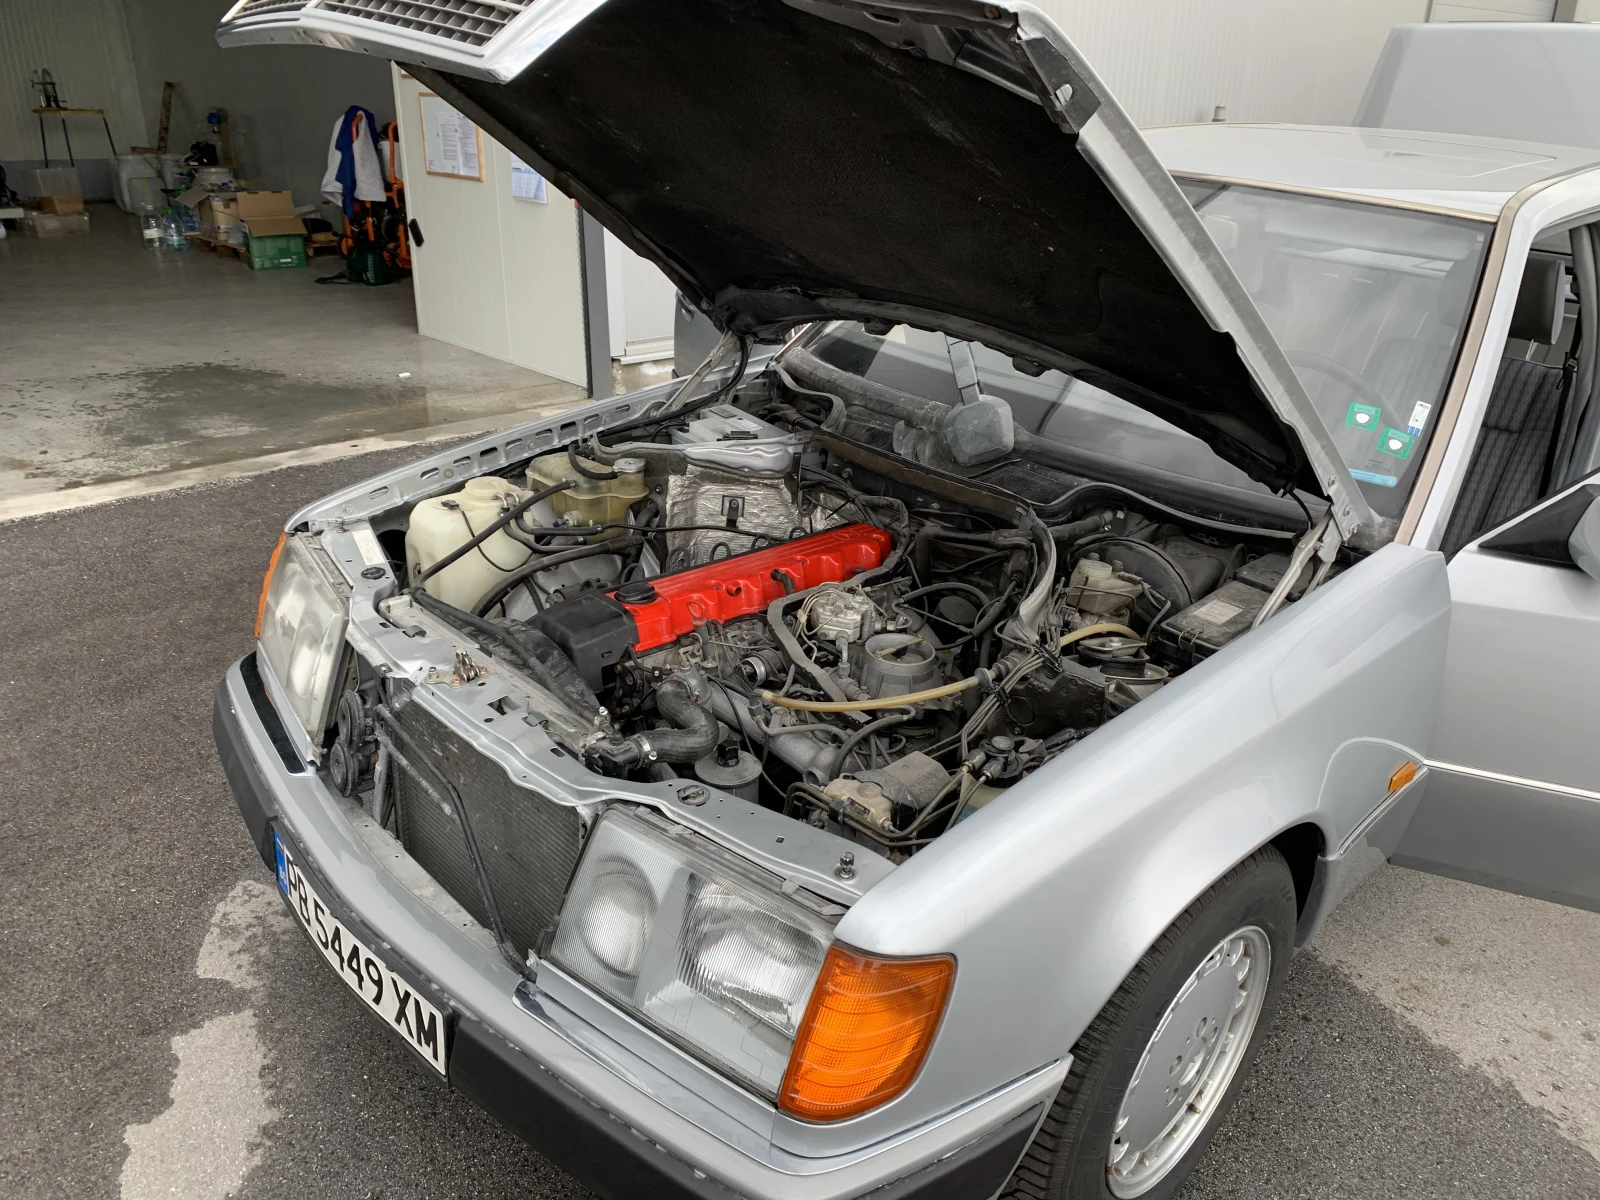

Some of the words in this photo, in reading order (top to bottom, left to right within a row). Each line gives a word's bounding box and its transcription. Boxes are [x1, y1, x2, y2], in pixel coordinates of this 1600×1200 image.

[286, 852, 311, 926] PB
[313, 897, 384, 1006] 5449
[391, 975, 439, 1062] XM
